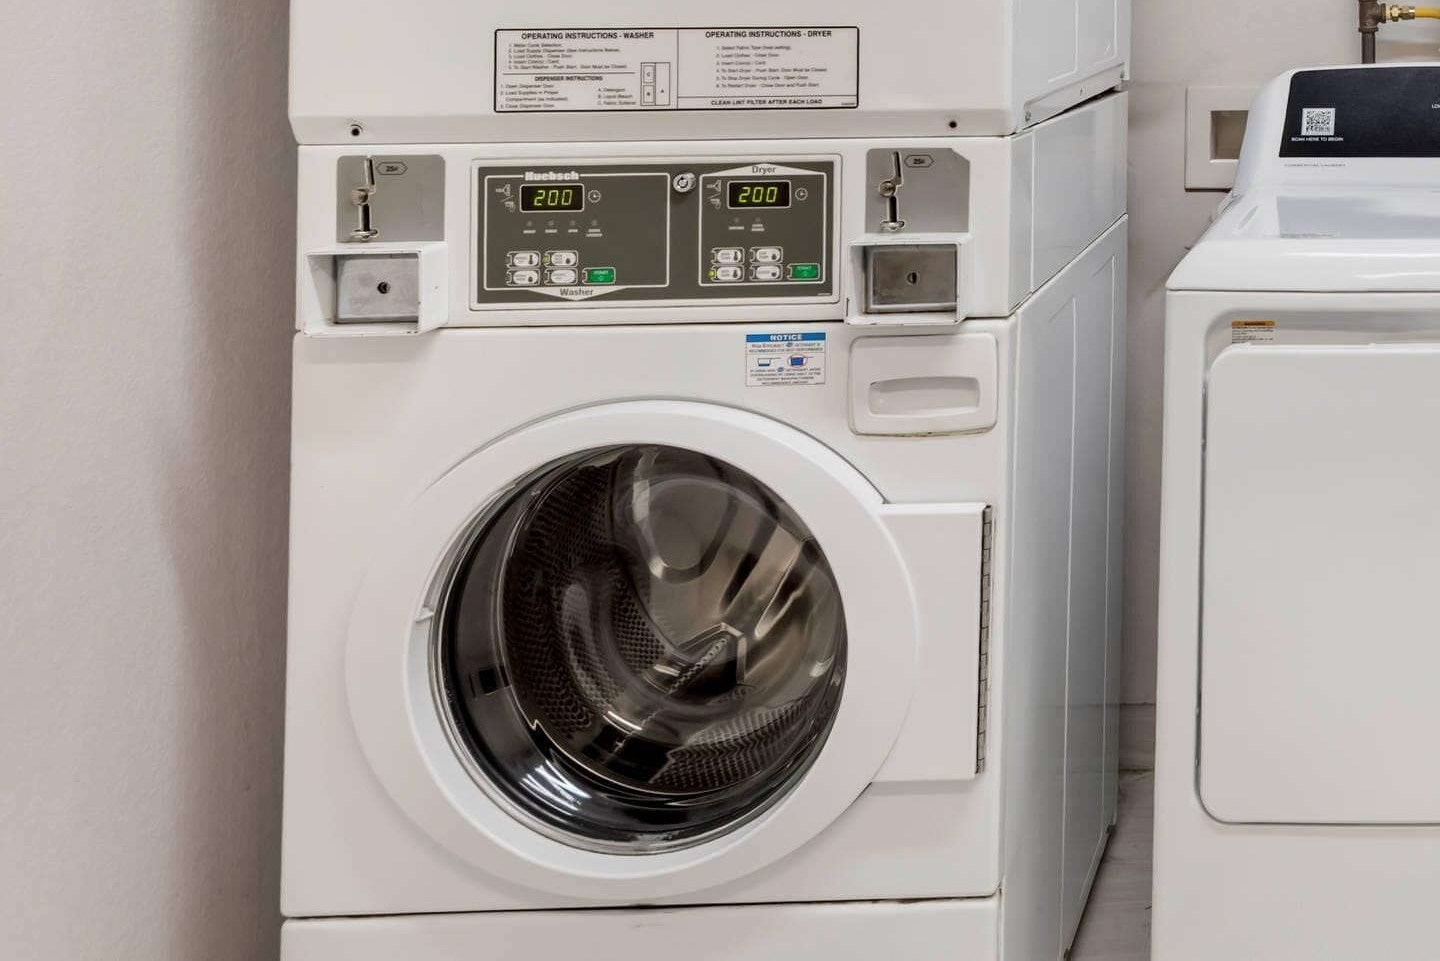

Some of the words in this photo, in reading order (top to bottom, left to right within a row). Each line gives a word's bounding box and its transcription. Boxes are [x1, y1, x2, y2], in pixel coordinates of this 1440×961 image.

[525, 171, 579, 181] Huebsch
[752, 166, 776, 174] Dryer
[533, 190, 573, 206] 200
[738, 187, 778, 203] 200
